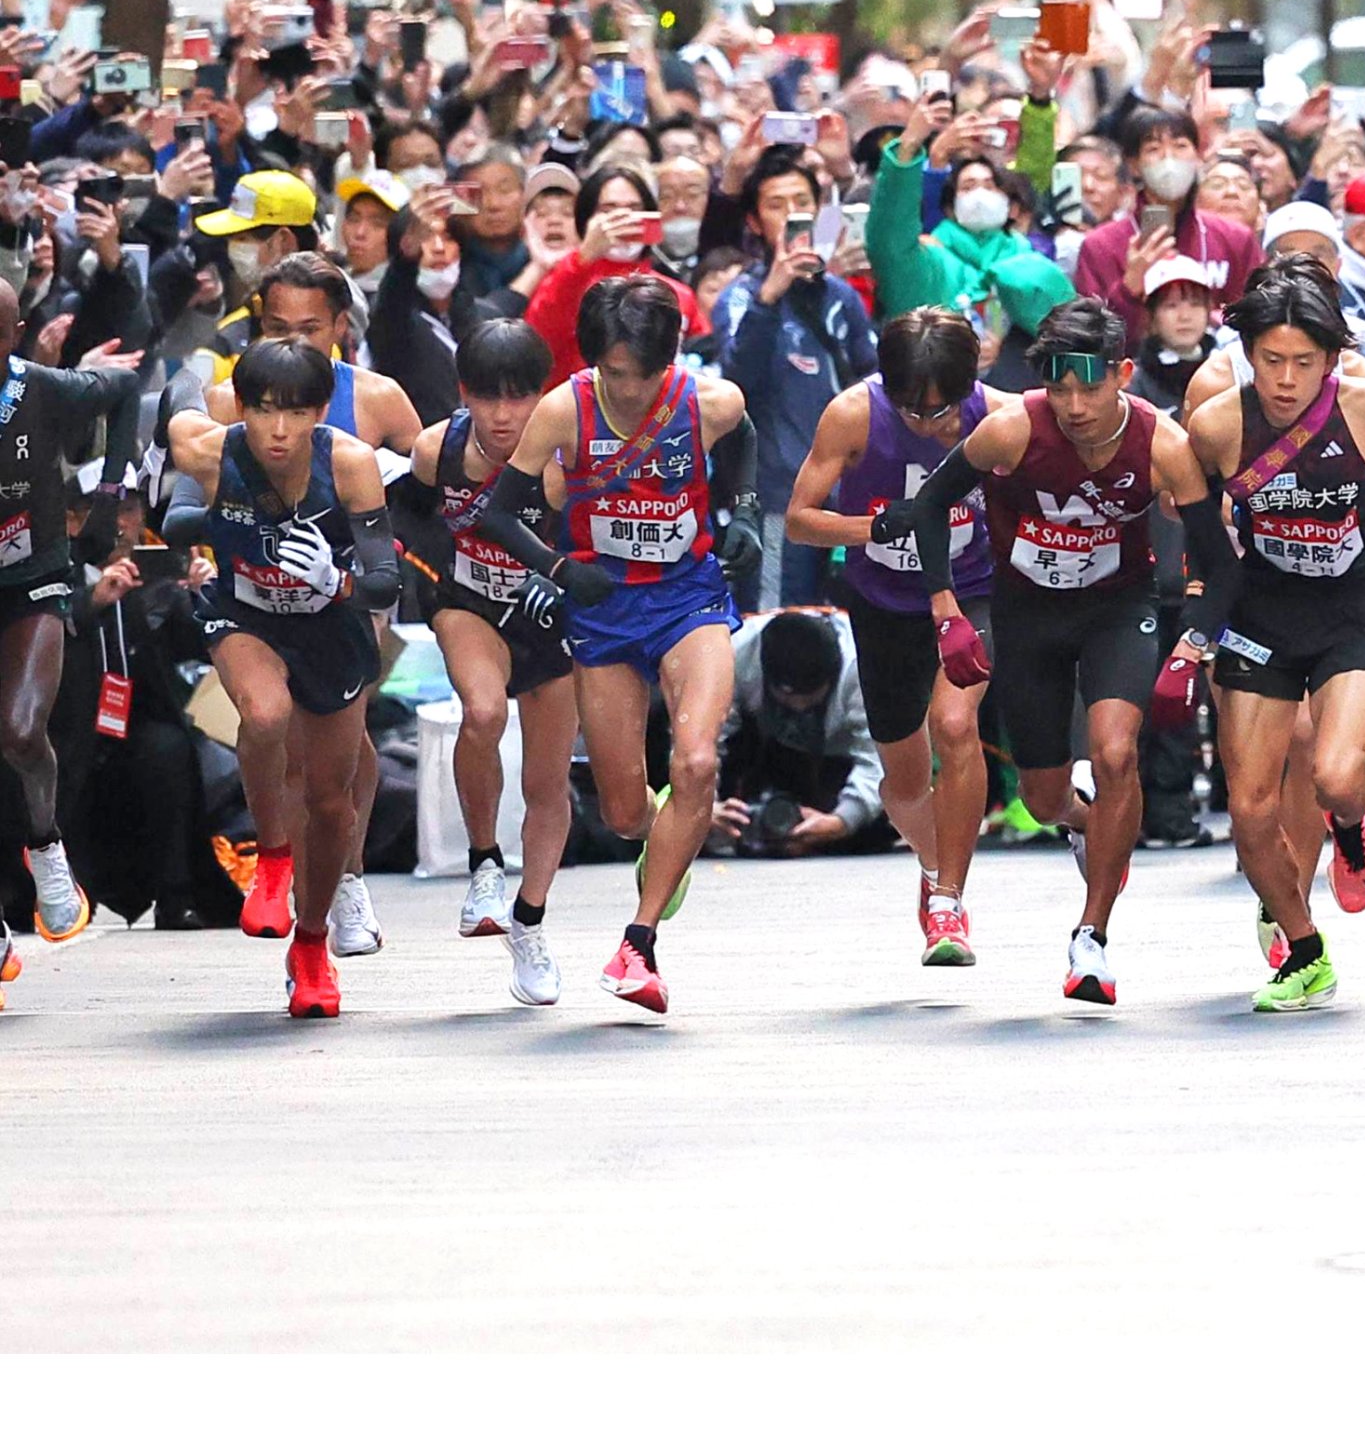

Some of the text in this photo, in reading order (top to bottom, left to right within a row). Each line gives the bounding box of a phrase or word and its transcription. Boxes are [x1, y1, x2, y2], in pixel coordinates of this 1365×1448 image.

[1249, 482, 1359, 513] 国学院大学
[609, 519, 685, 544] 創価大
[631, 543, 666, 560] 8-1
[897, 553, 919, 569] 16
[1049, 571, 1084, 587] 6-1
[1231, 636, 1270, 664] アサガミ
